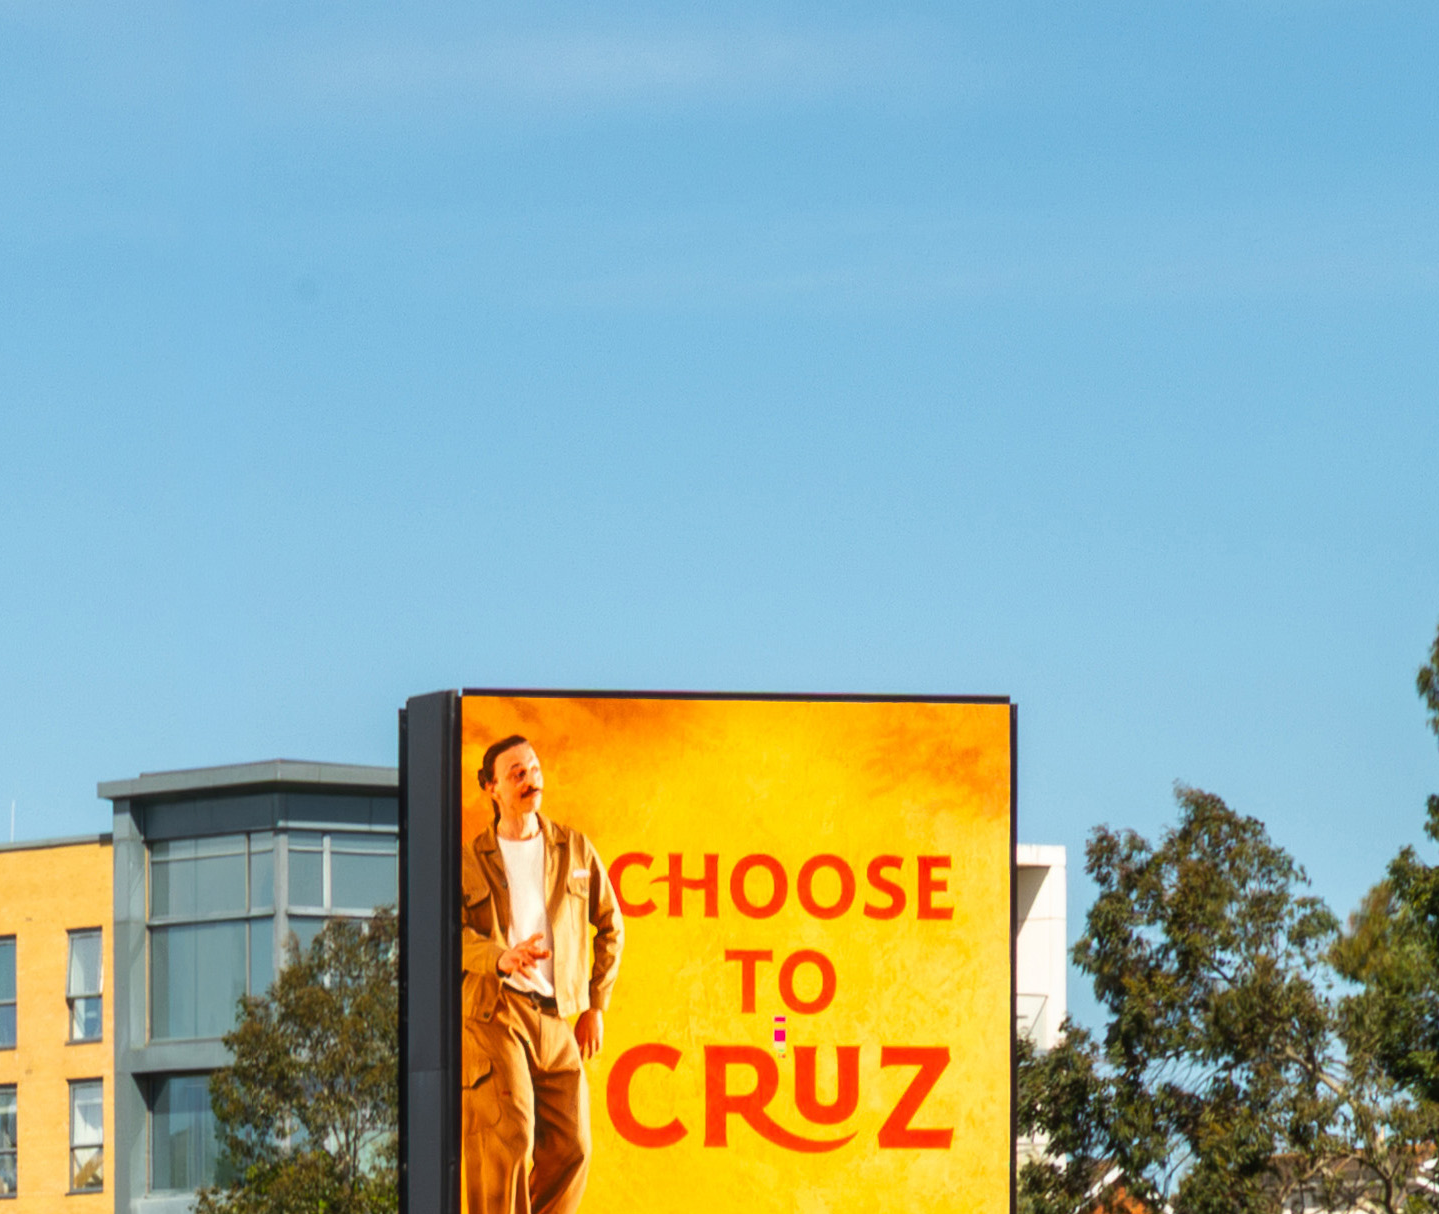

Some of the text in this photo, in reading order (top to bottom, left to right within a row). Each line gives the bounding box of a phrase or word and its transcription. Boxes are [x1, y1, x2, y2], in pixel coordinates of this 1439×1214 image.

[608, 852, 954, 920] CHOOSE
[724, 949, 837, 1015] TO
[606, 1043, 954, 1153] CRUZ
